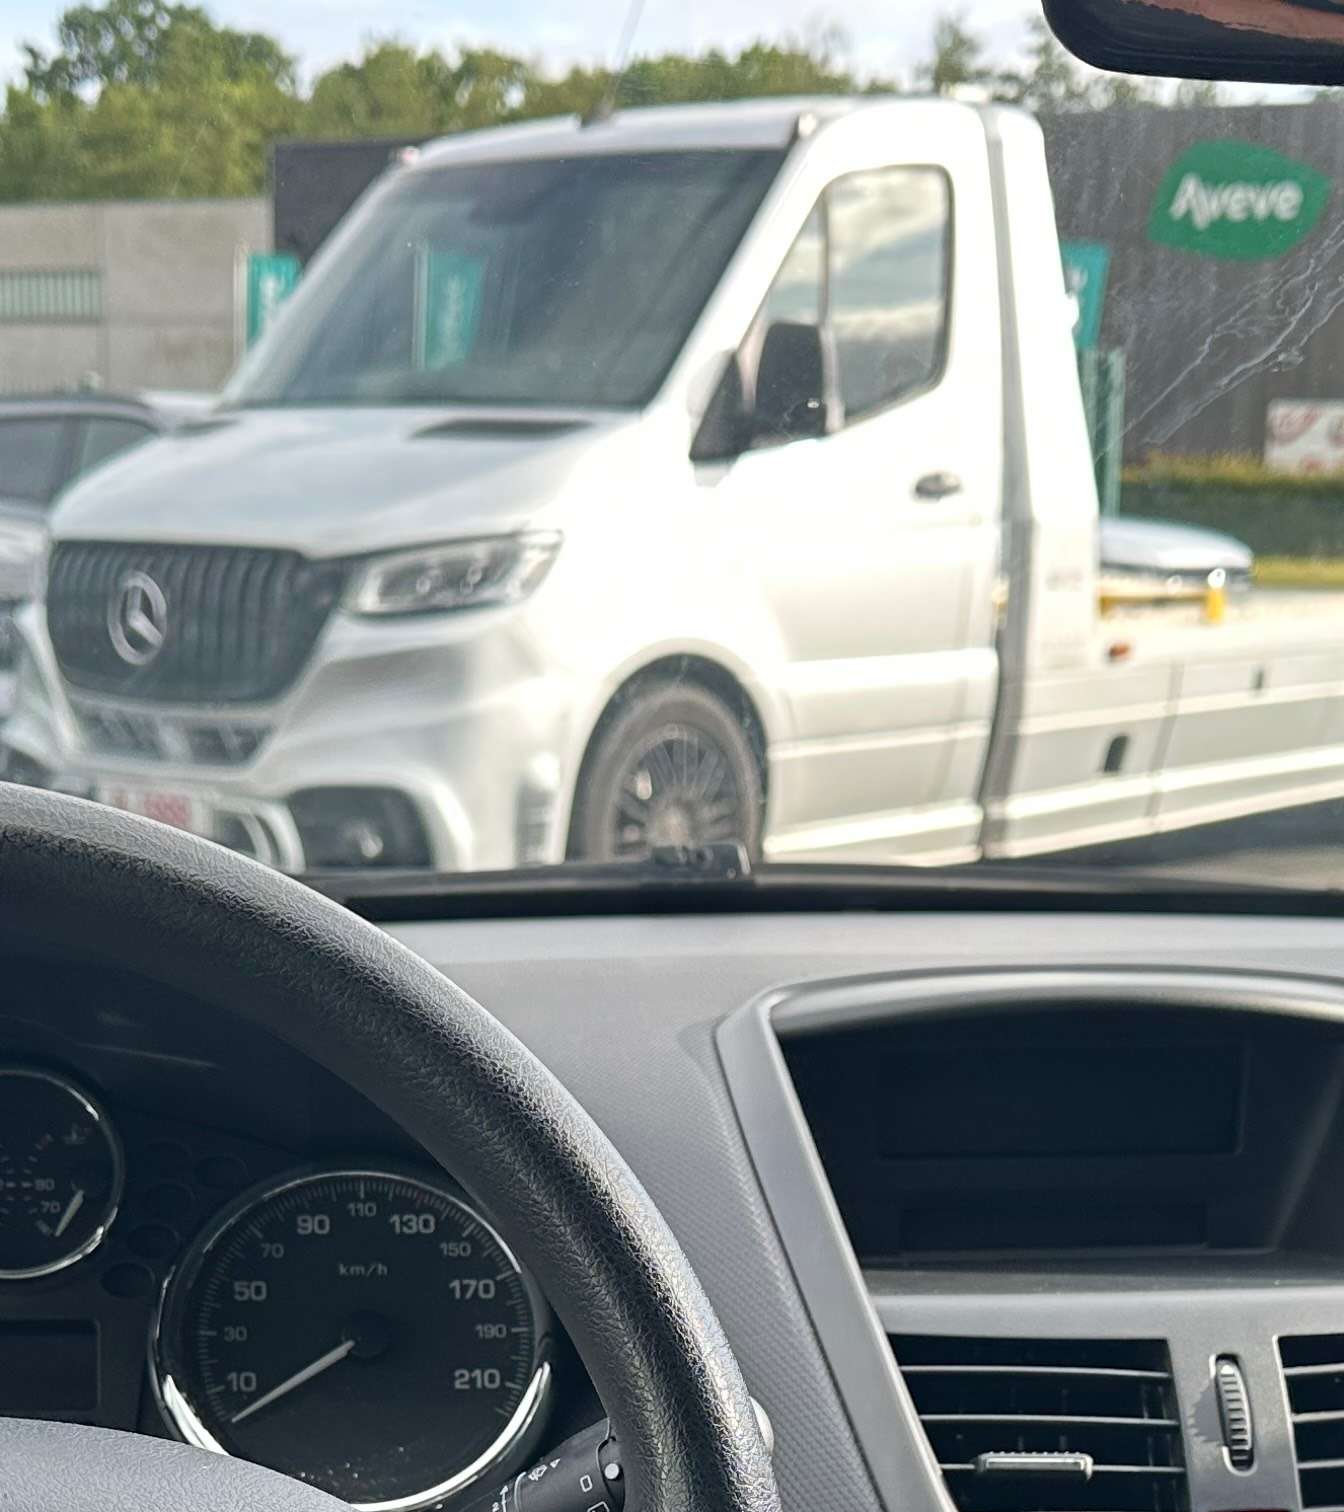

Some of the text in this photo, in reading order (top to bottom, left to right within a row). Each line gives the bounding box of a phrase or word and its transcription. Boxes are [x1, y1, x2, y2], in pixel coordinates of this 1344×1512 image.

[348, 1202, 376, 1217] 110
[297, 1215, 330, 1235] 90
[389, 1213, 435, 1234] 130
[261, 1244, 284, 1258] 70
[440, 1241, 471, 1257] 150
[338, 1262, 387, 1277] km/h
[234, 1281, 267, 1300] 50
[449, 1279, 495, 1299] 170
[224, 1326, 247, 1341] 30
[475, 1323, 507, 1339] 190
[228, 1372, 257, 1392] 10
[454, 1369, 500, 1390] 210
[492, 1502, 500, 1512] 2
